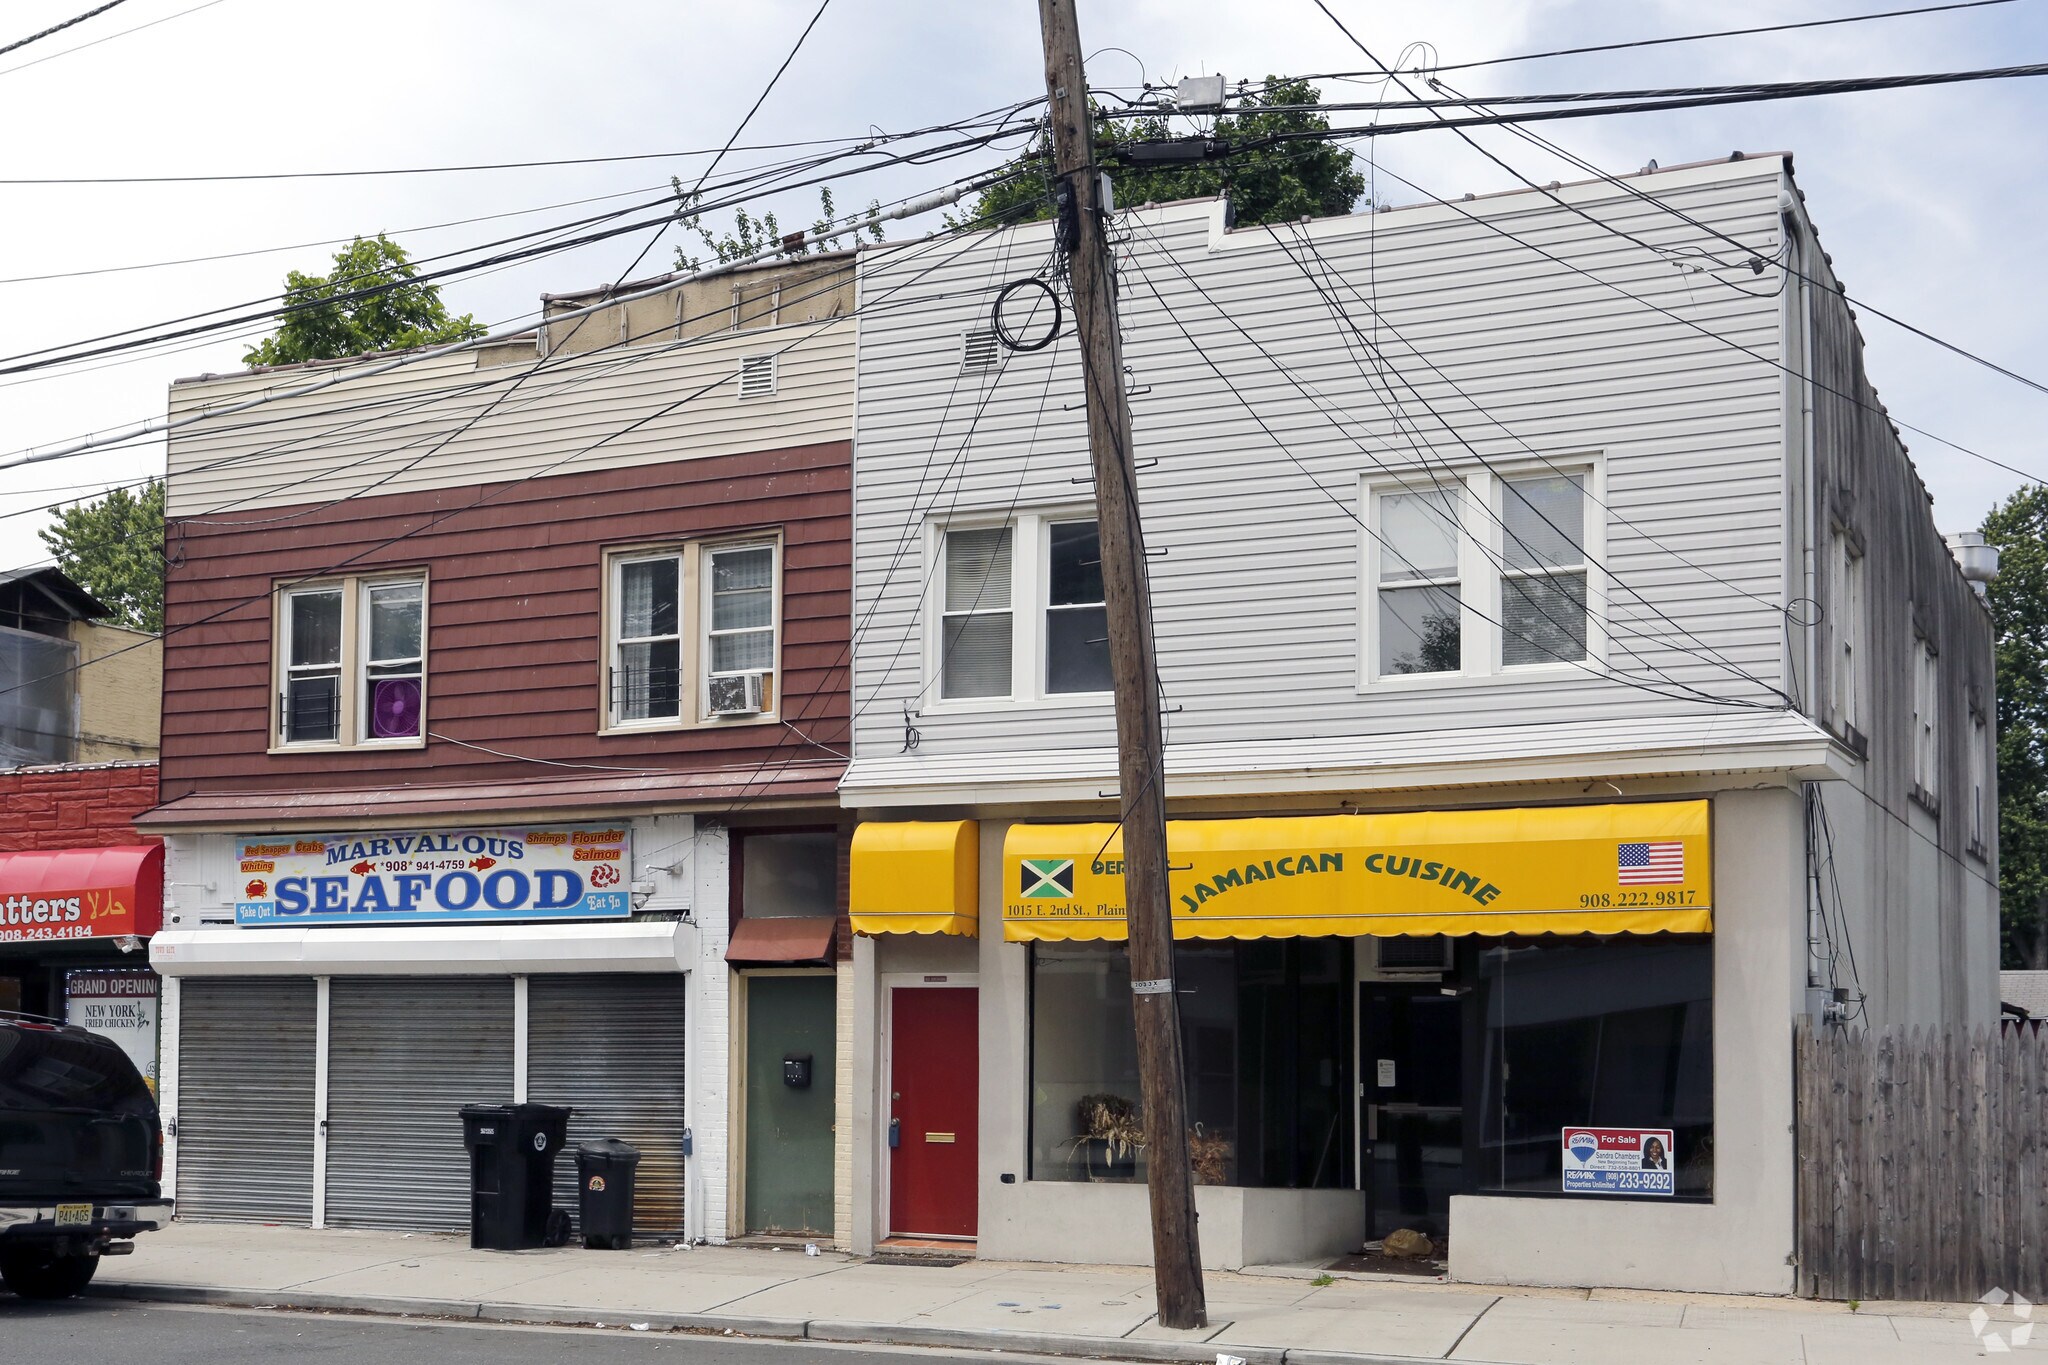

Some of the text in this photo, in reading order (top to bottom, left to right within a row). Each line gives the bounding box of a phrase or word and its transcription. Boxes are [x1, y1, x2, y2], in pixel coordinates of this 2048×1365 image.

[527, 833, 567, 845] Shrimps
[572, 830, 625, 844] Flounder
[245, 844, 290, 857] Red Snapper
[294, 840, 325, 854] Crabs
[325, 834, 524, 866] MARVALOUS
[573, 848, 620, 861] Salmon
[241, 861, 274, 873] Whiting
[416, 859, 465, 871] 941-4759
[1180, 852, 1502, 914] JAMAICAN CUISINE
[274, 868, 585, 917] SEAFOOD
[1579, 889, 1697, 909] 908.222.9817
[587, 895, 621, 910] Eat In
[240, 905, 271, 919] Take Out
[1008, 904, 1033, 916] 1015
[1037, 904, 1046, 916] E.
[1050, 903, 1071, 916] 2nd
[1097, 903, 1127, 916] Plain
[70, 979, 107, 994] GRAND
[85, 1005, 136, 1018] NEW YORK
[85, 1018, 136, 1028] FRIED CHICKEN
[1601, 1136, 1636, 1144] For Sale
[1595, 1152, 1640, 1160] Sandra Chambers
[1566, 1170, 1596, 1180] RE/MAX
[1619, 1172, 1671, 1190] 233-9292
[1566, 1181, 1616, 1189] Properties Unlimited
